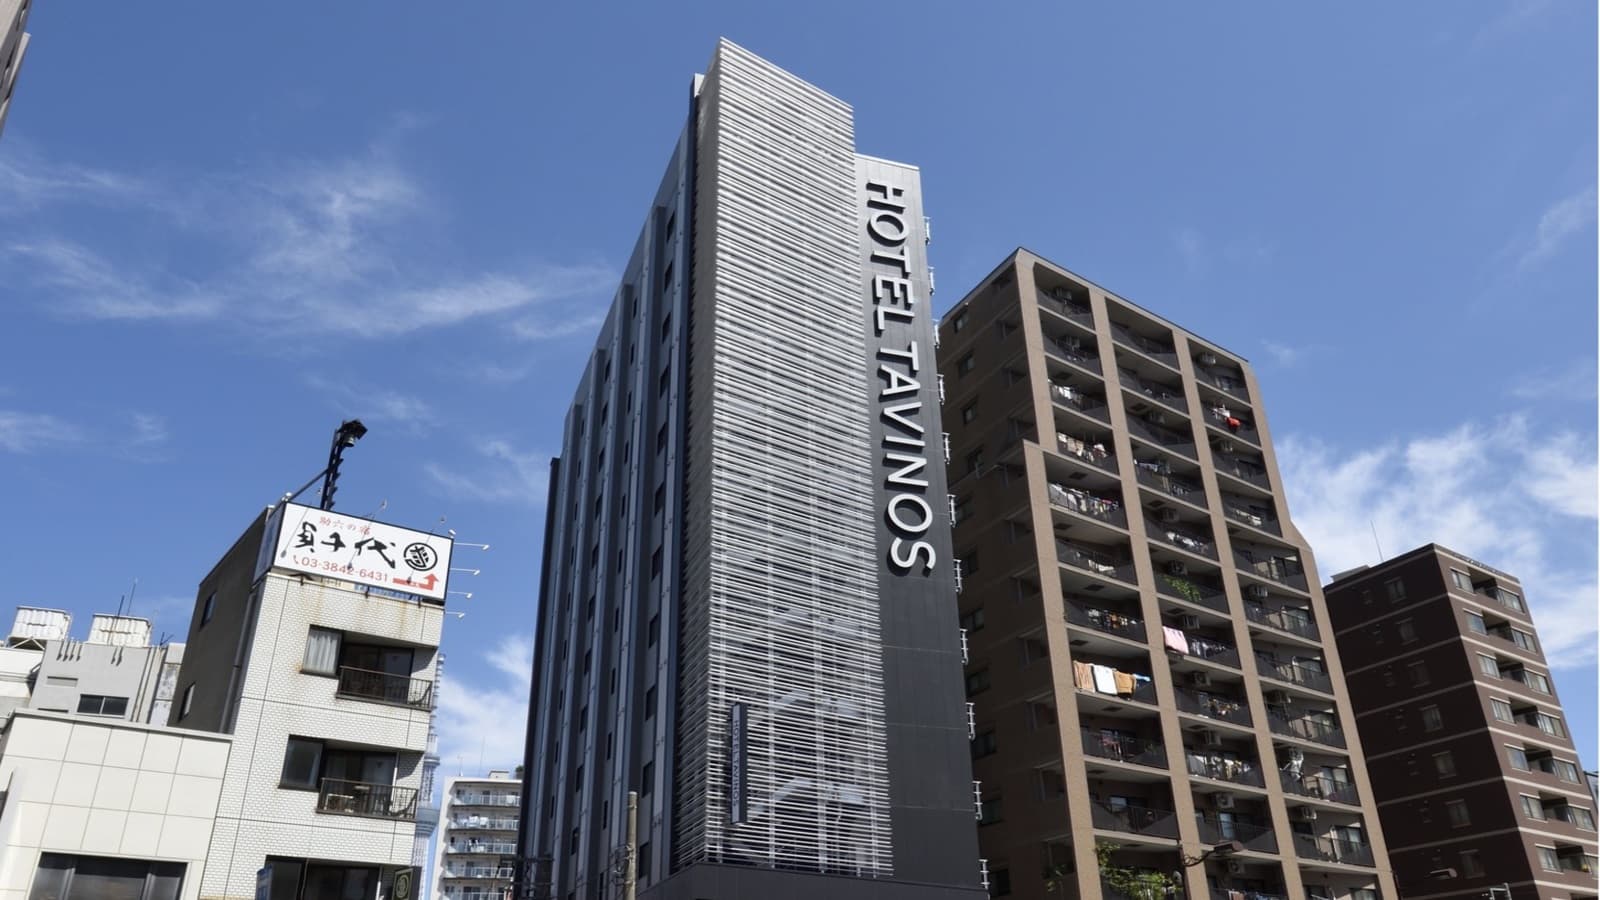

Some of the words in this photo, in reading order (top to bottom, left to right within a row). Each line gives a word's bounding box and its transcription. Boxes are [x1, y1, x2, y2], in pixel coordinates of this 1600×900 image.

[867, 179, 915, 332] HOTEL
[879, 341, 936, 569] TAVINOS
[301, 556, 388, 582] 03-3842-6431
